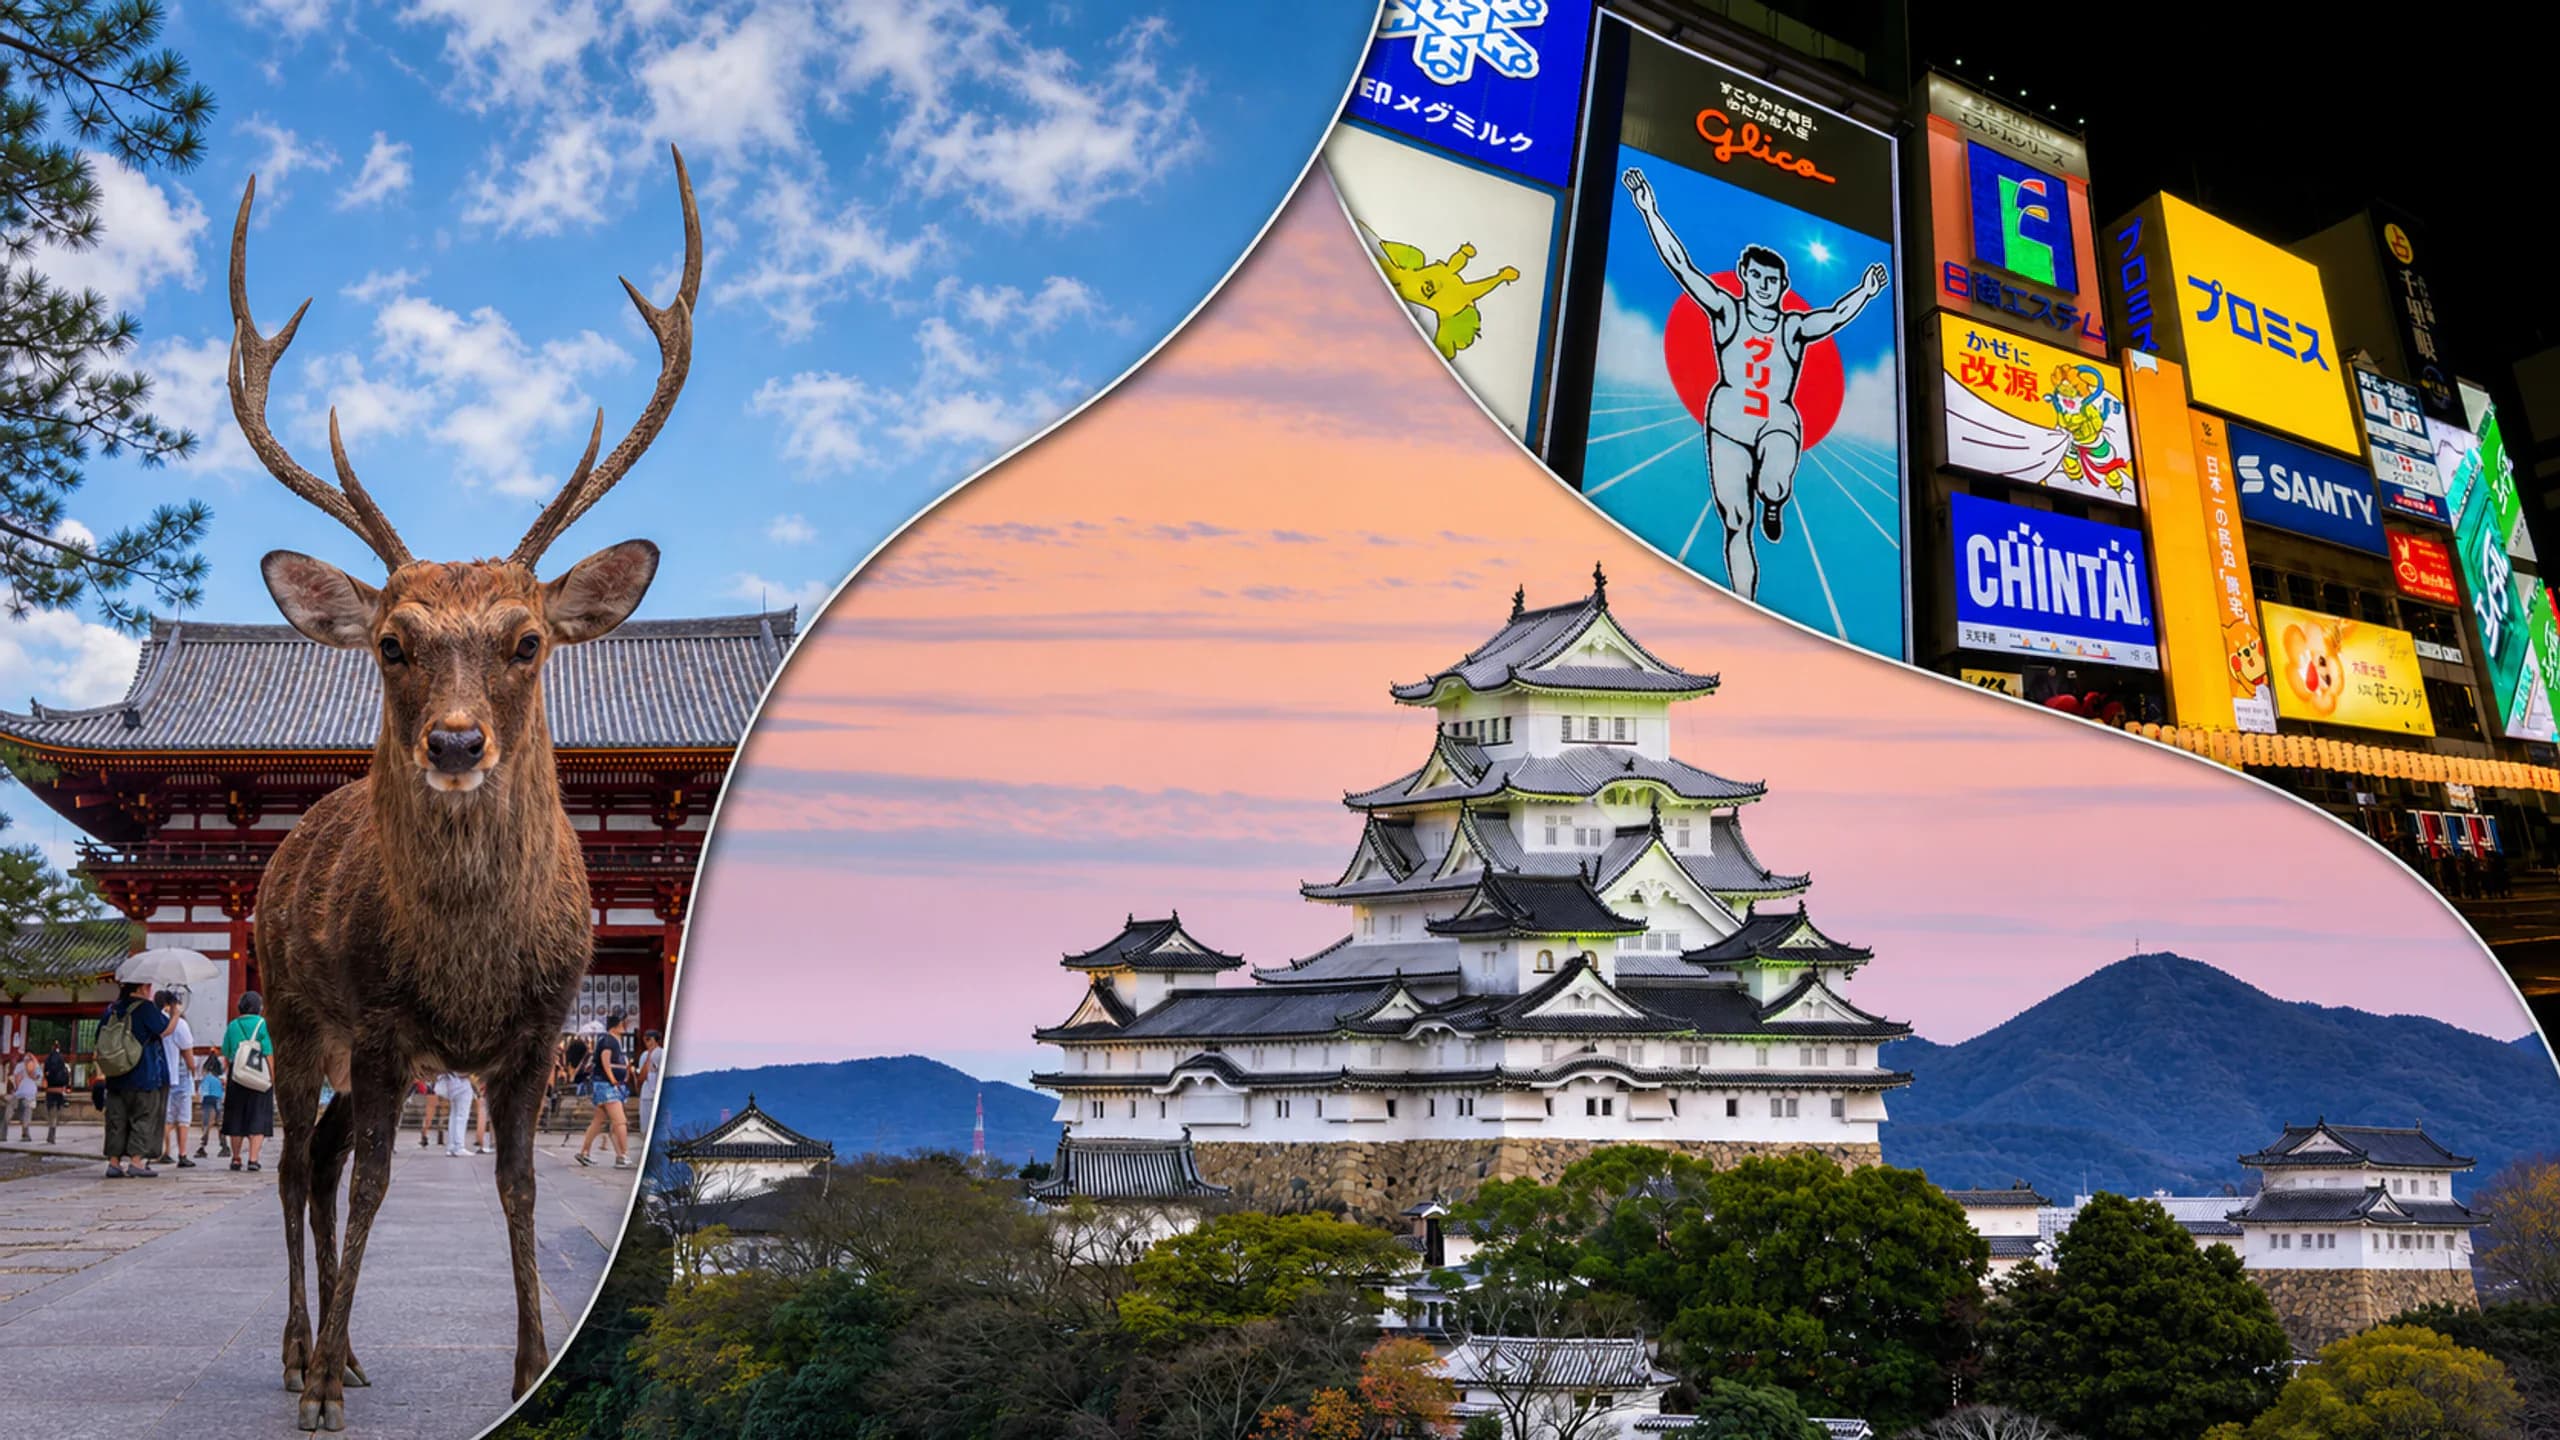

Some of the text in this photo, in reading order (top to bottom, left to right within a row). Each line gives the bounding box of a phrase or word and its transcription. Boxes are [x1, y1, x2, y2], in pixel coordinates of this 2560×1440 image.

[1966, 330, 2030, 366] かぜに
[2187, 274, 2330, 371] プロミス
[1743, 336, 1776, 419] グリコ
[1959, 352, 2041, 402] 改源
[2269, 463, 2373, 526] SAMTY
